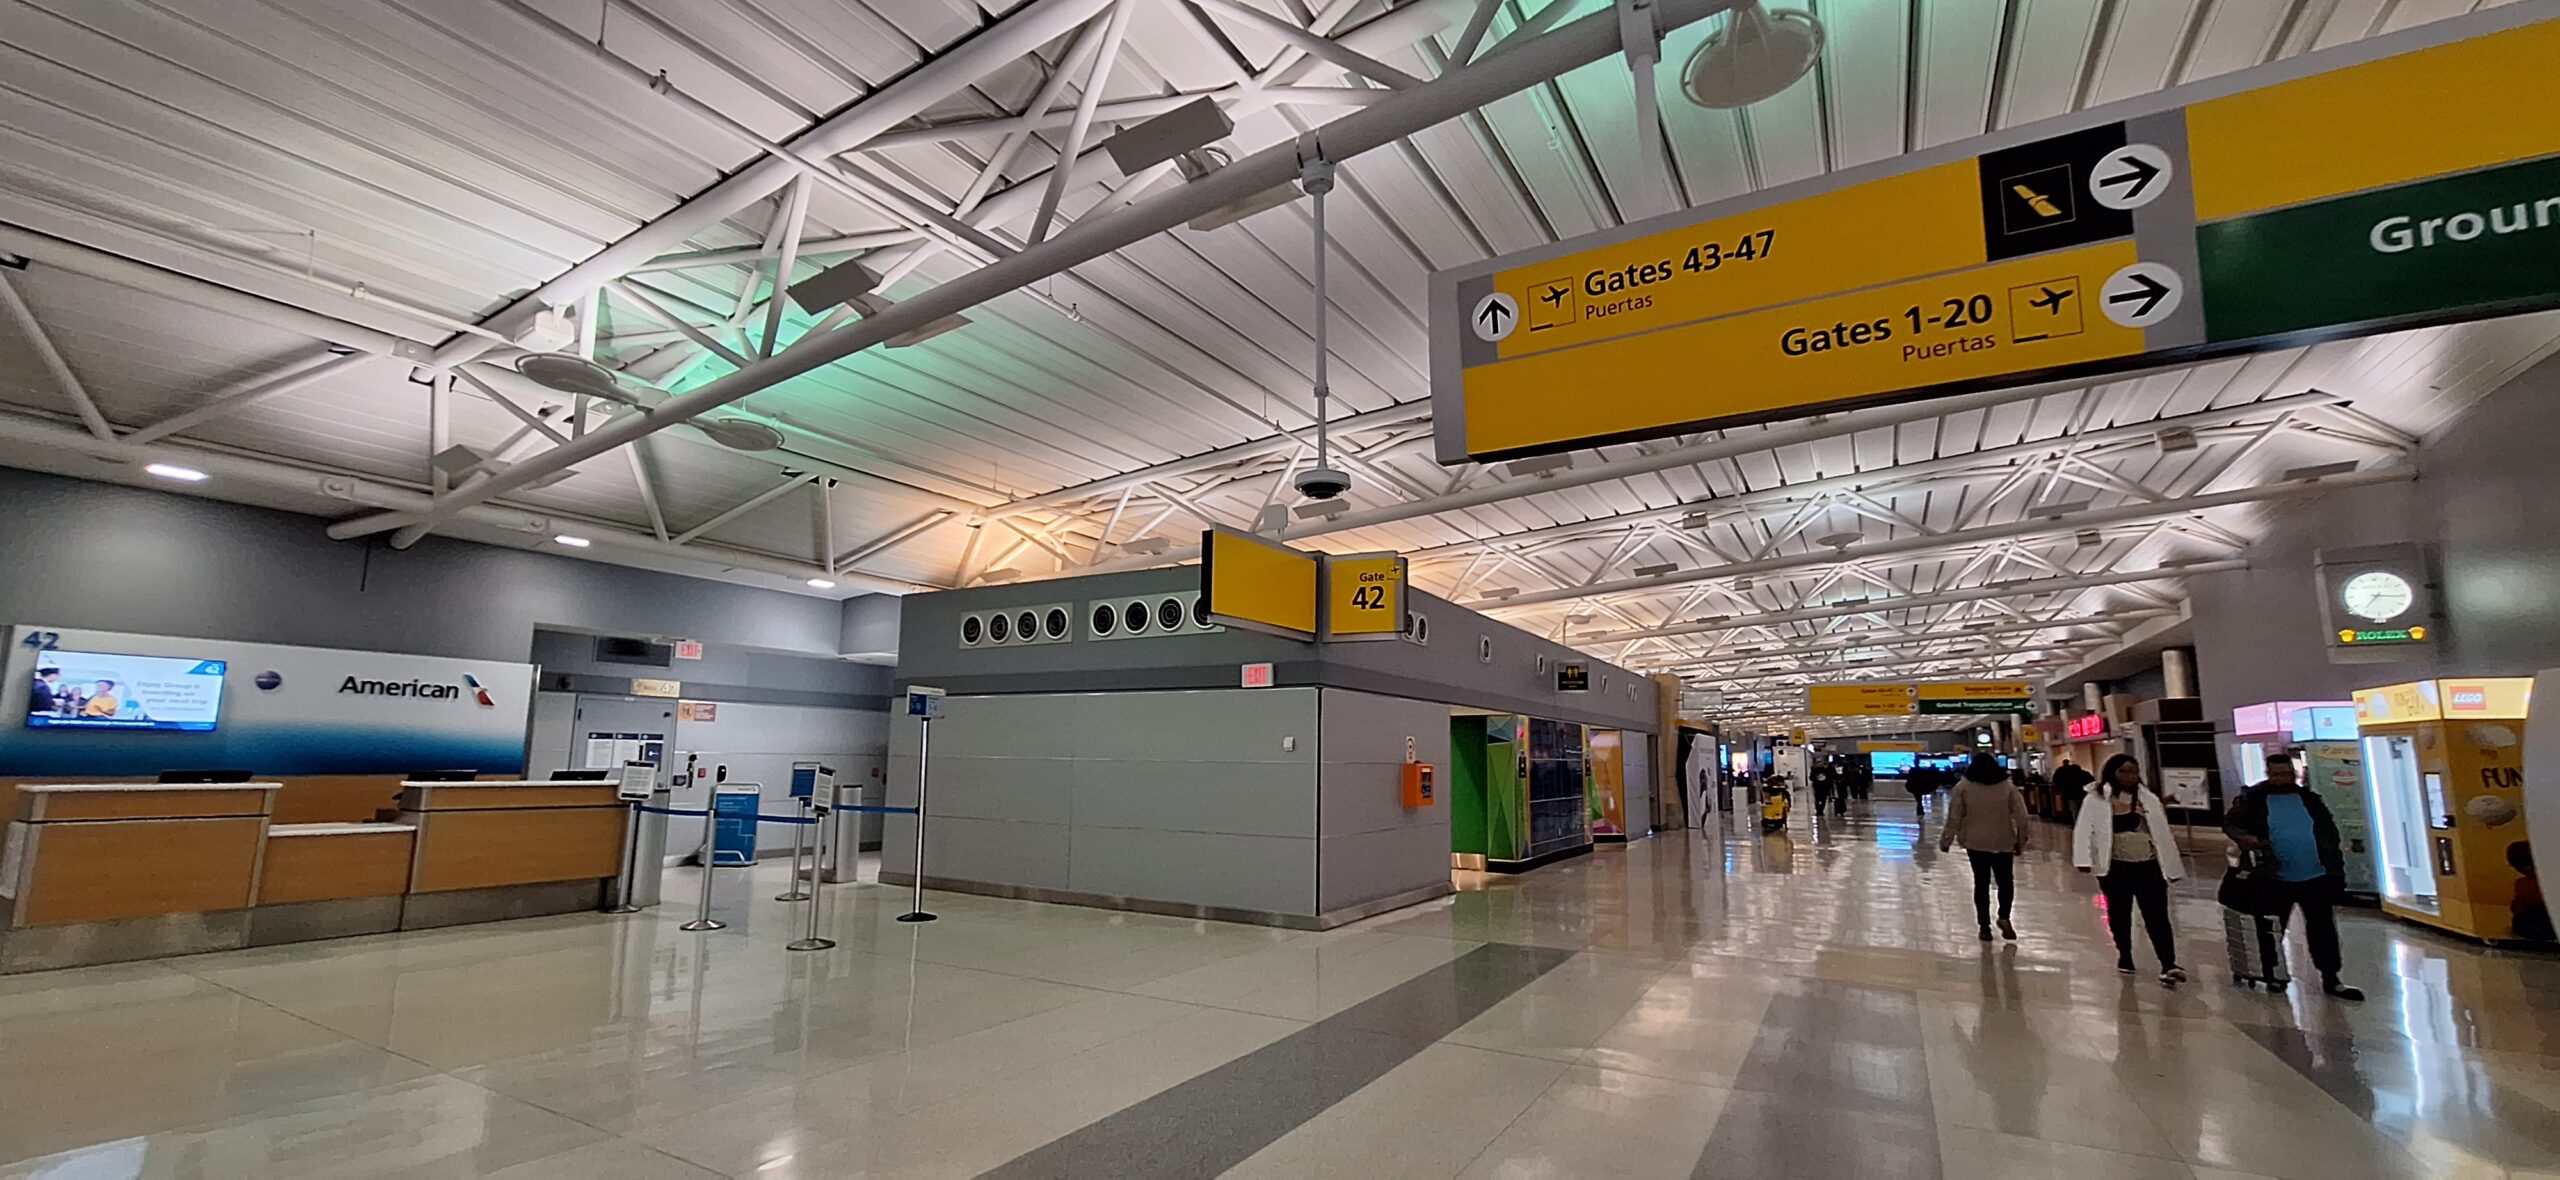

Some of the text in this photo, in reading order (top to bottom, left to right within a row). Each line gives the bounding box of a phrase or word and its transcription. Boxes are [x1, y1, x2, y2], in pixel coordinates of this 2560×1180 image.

[1584, 229, 1776, 297] Gates 43-47
[1585, 293, 1654, 321] Puertas
[1780, 293, 1993, 357] Gates 1-20
[1902, 332, 1996, 363] Puertas
[1359, 572, 1385, 583] Gate
[1352, 585, 1385, 610] 42
[22, 630, 60, 651] 42
[2356, 629, 2409, 641] ROLEX
[680, 643, 699, 657] EXIT
[338, 675, 460, 699] American
[1247, 666, 1267, 686] EXIT
[2455, 694, 2482, 703] LEGO
